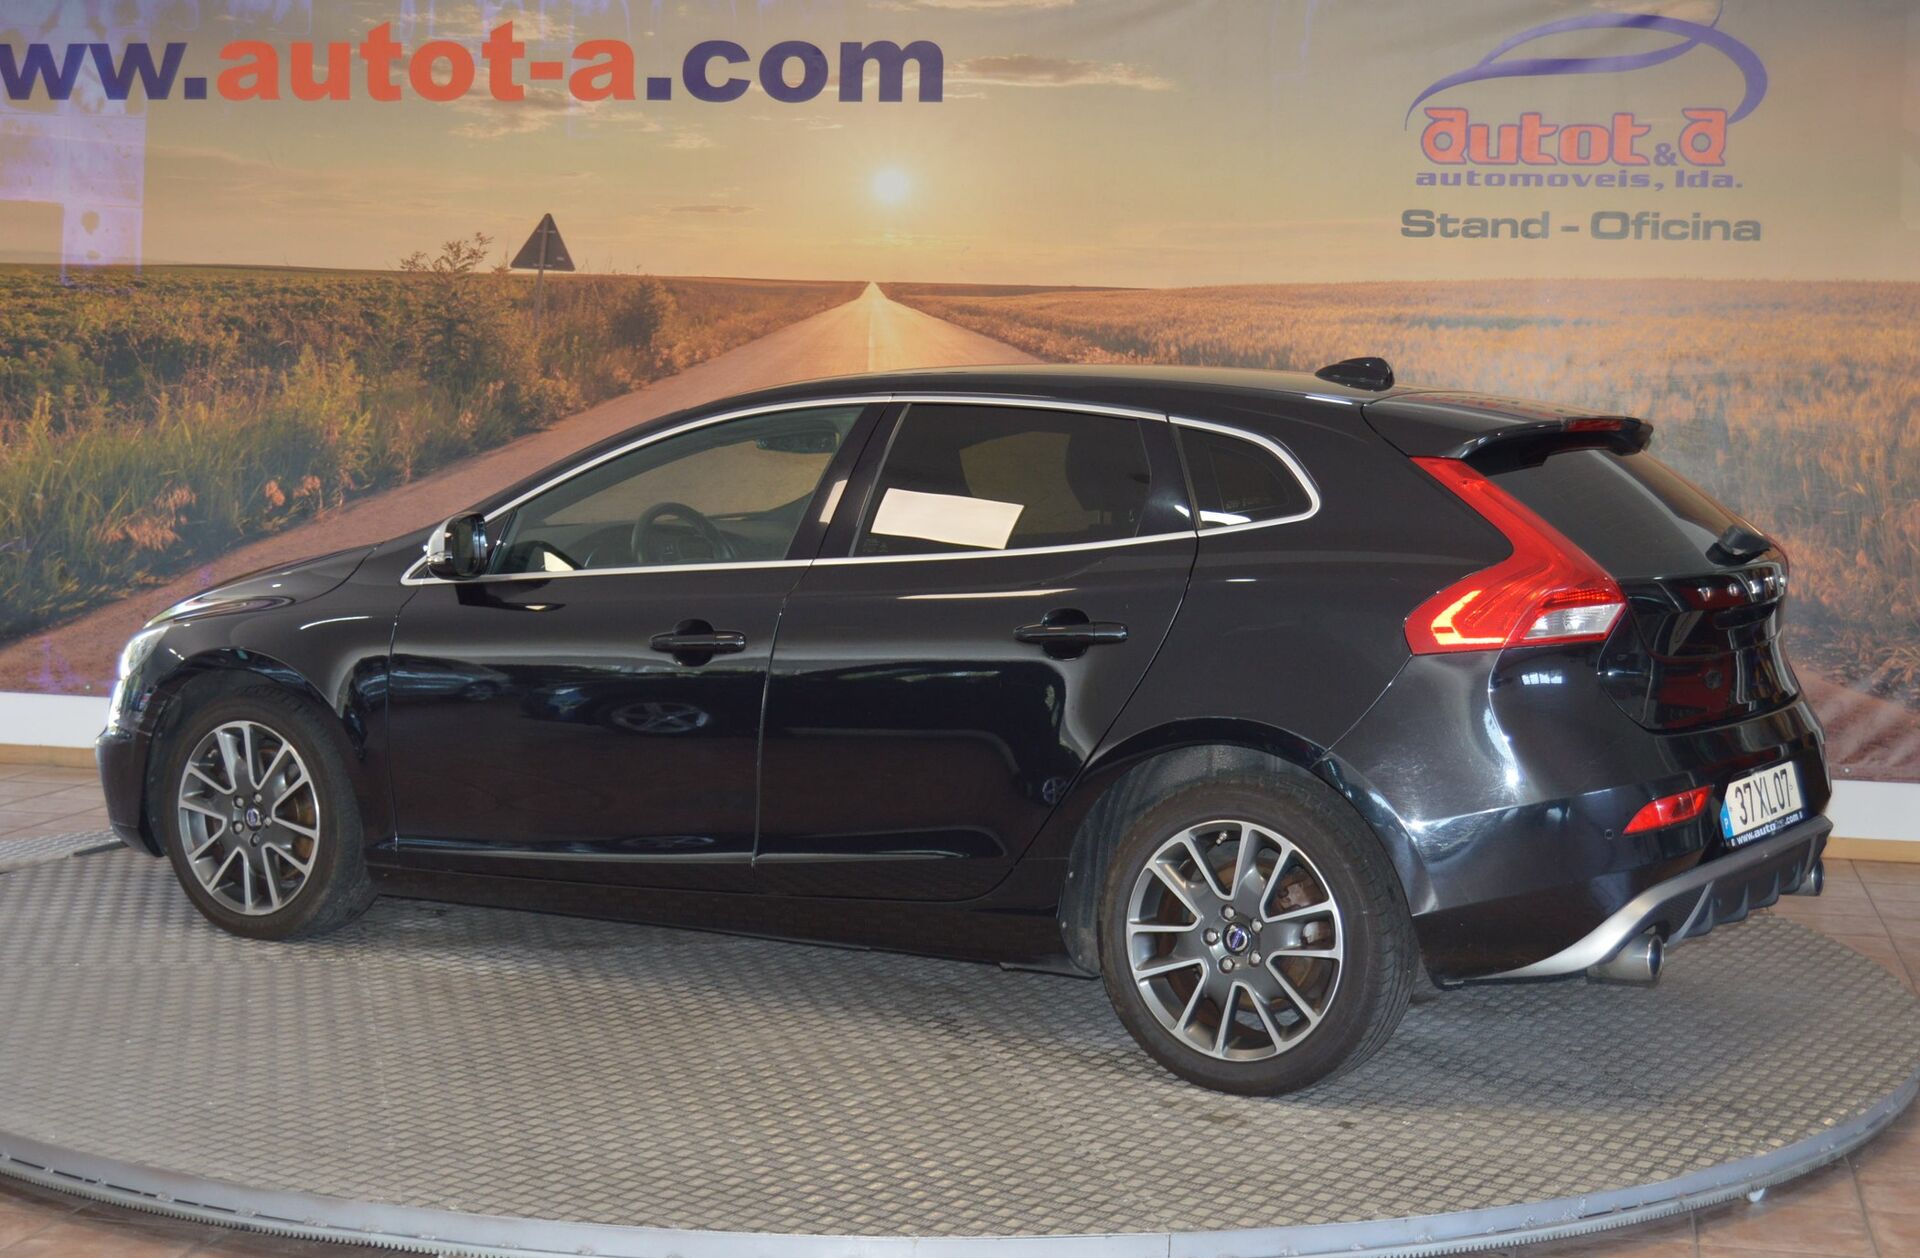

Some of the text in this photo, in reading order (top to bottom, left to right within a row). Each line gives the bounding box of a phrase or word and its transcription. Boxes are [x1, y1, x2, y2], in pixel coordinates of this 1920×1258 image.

[1416, 170, 1743, 191] automoveis, lda.
[1401, 209, 1550, 239] Stand
[1590, 211, 1762, 241] Oficina
[1723, 817, 1729, 830] P
[1736, 812, 1799, 846] www.auto.com
